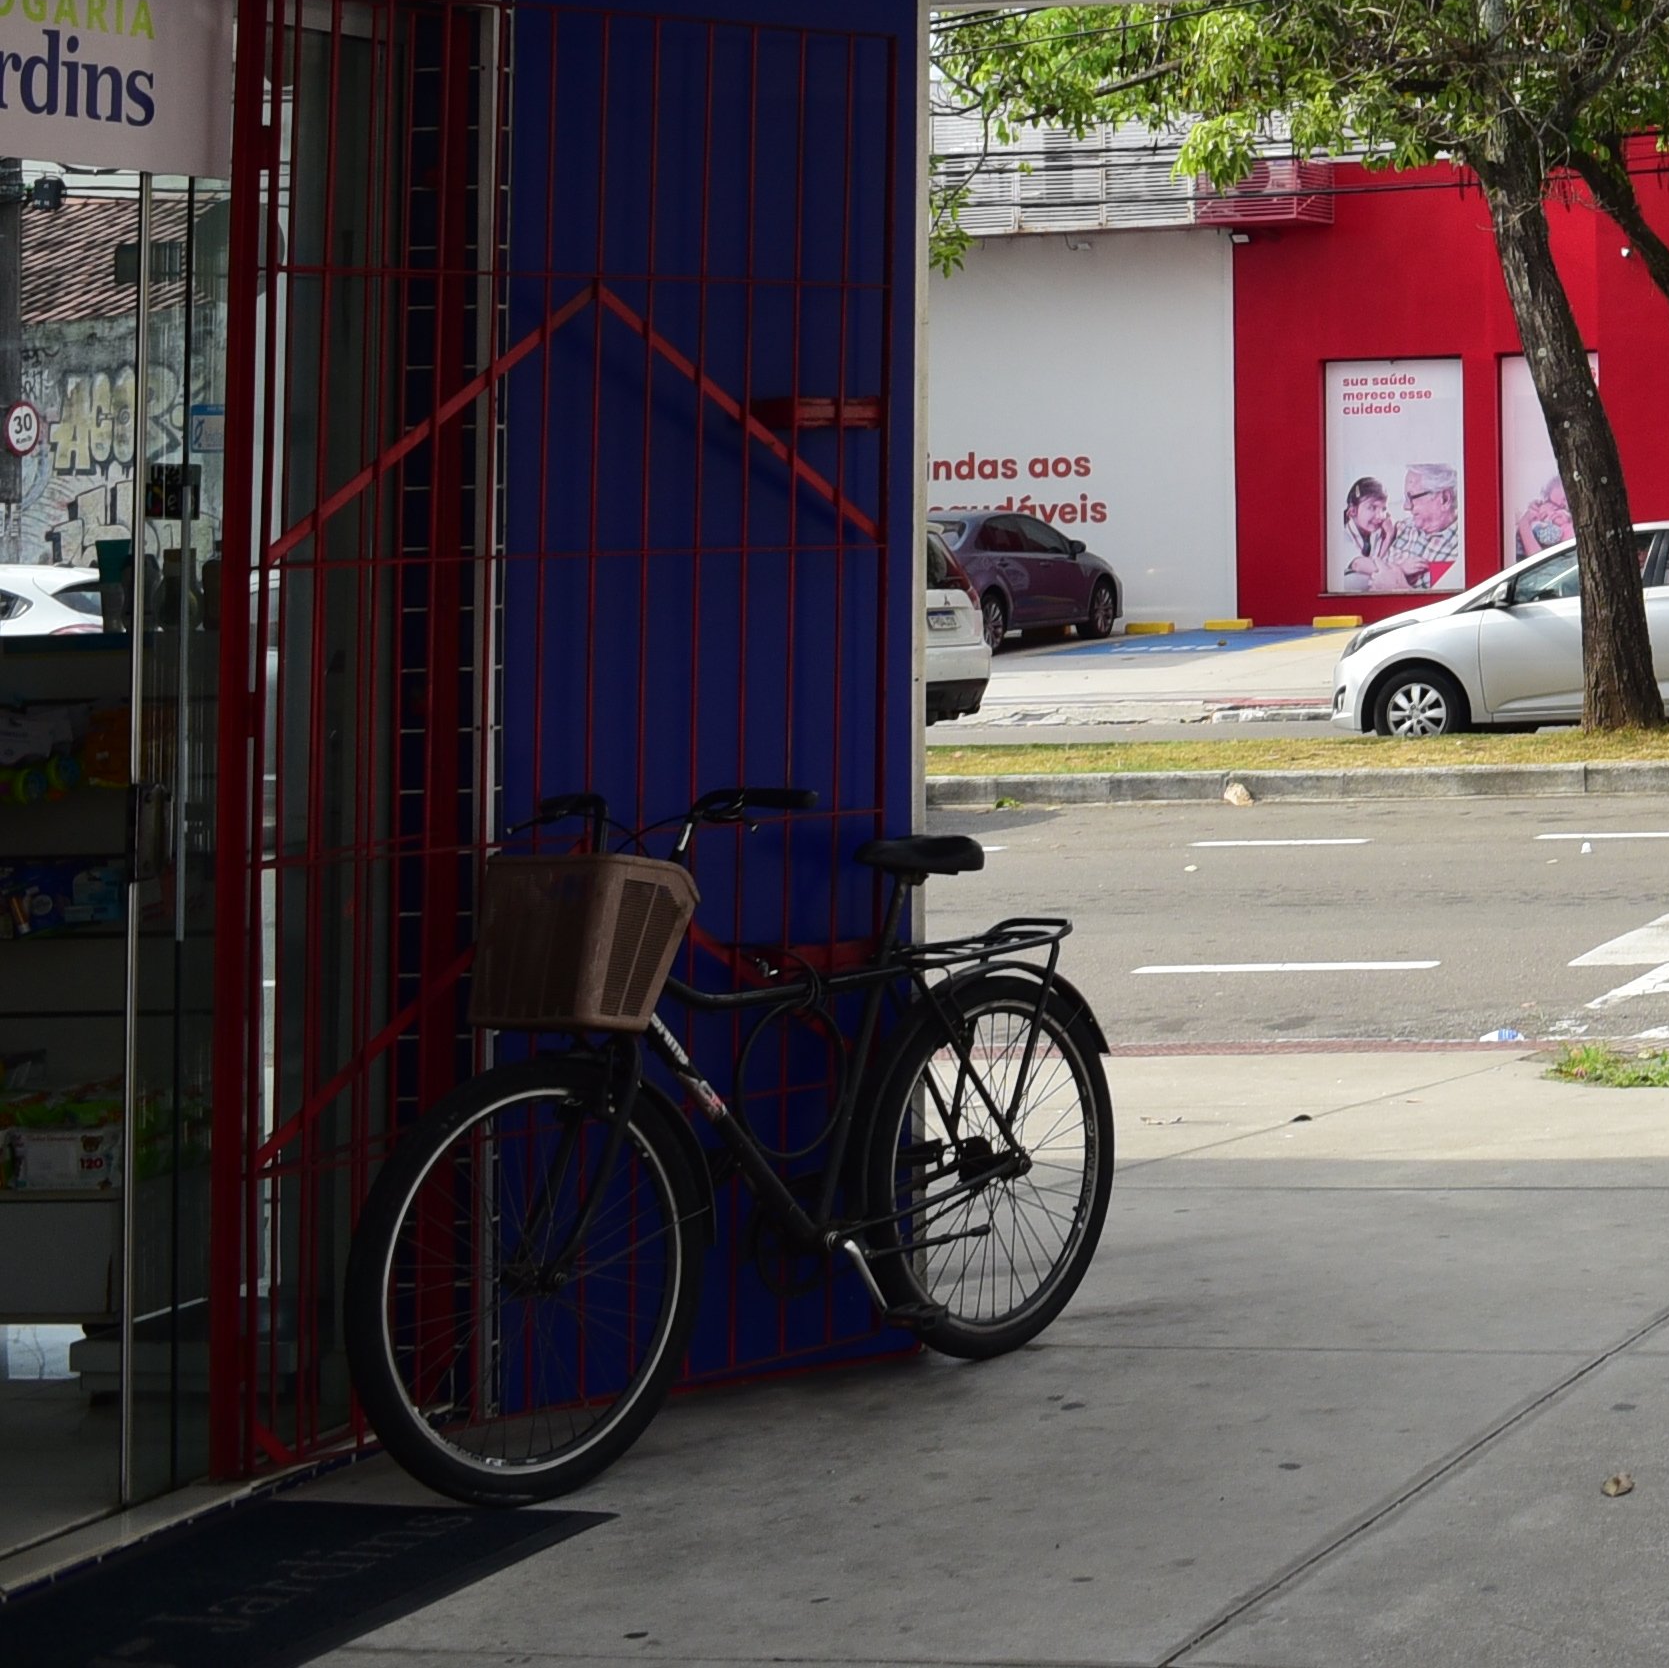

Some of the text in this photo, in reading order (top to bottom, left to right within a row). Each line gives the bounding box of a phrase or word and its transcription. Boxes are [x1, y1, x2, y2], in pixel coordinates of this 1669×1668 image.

[1343, 373, 1416, 387] sua saúde
[1343, 390, 1432, 401] merece esse
[1343, 402, 1401, 415] cuidado
[13, 412, 33, 435] 30
[1028, 456, 1091, 478] aos
[80, 1157, 103, 1170] 120
